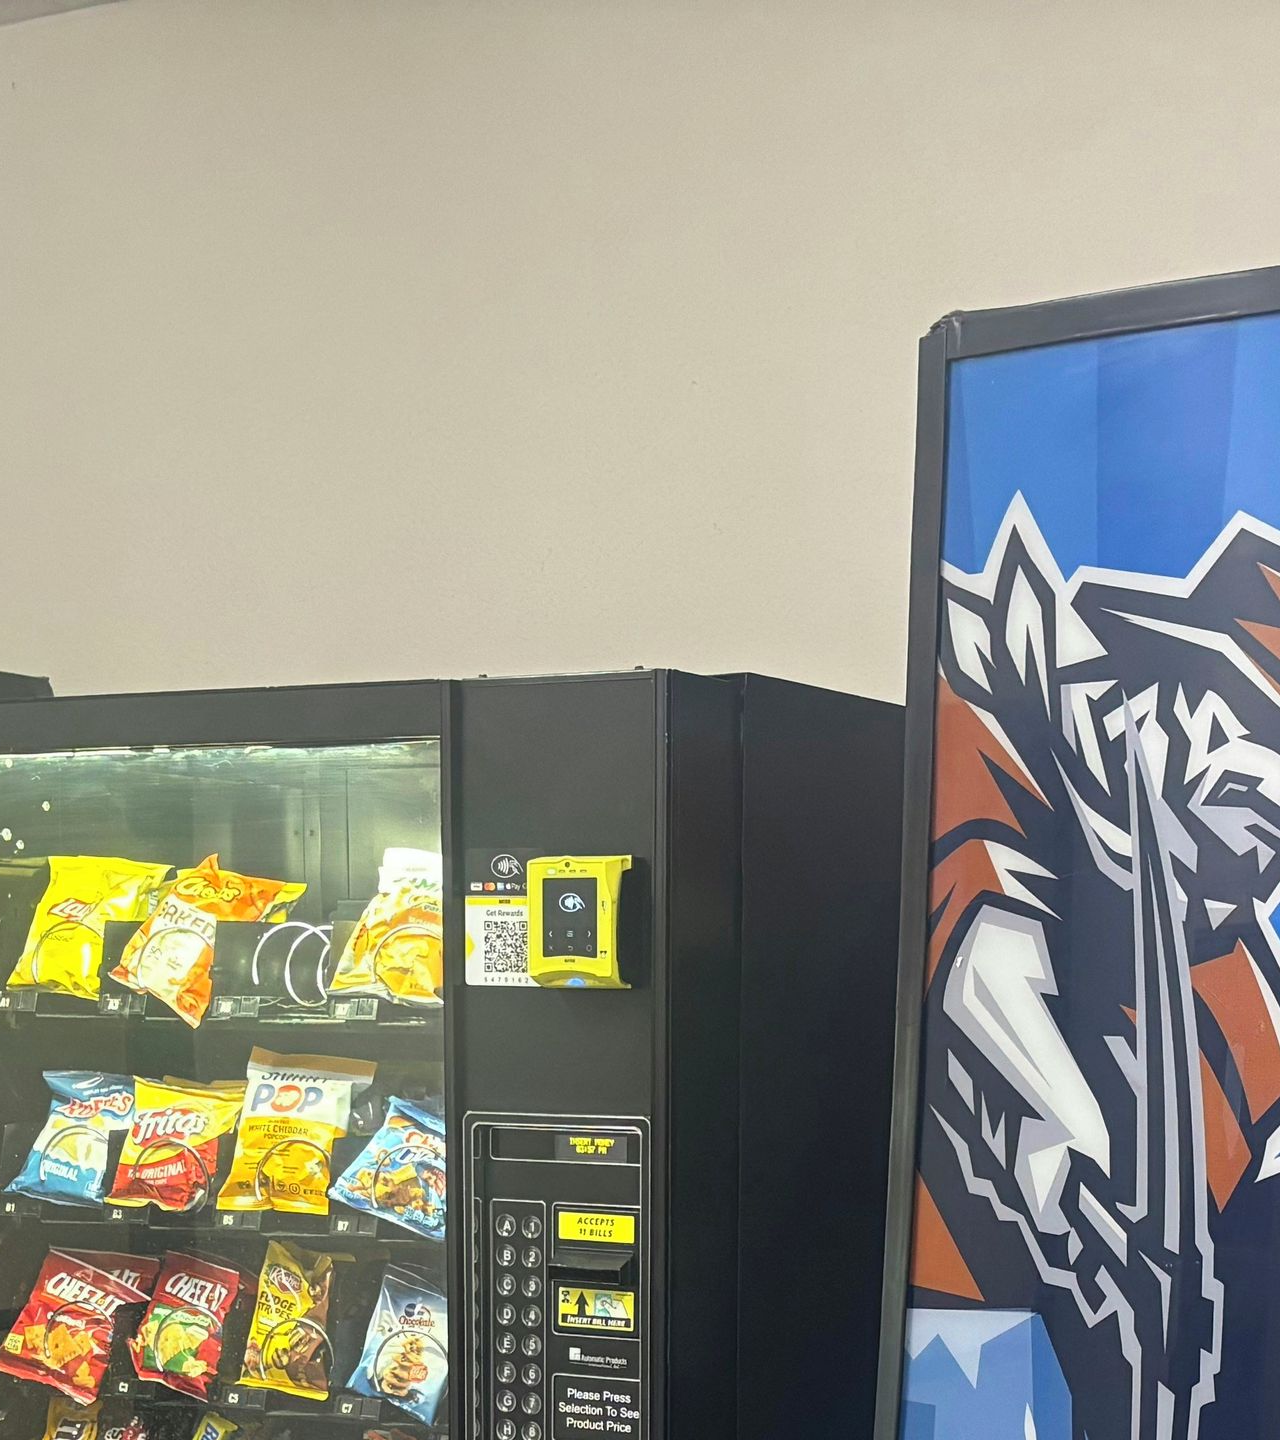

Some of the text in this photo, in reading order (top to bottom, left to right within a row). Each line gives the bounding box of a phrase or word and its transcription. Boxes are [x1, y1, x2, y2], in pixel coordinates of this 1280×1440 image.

[486, 909, 523, 917] Get Rewards
[250, 1083, 324, 1113] POP
[132, 1108, 208, 1144] Fritos
[272, 1124, 309, 1137] CHEDDAR
[569, 1136, 615, 1147] INSERT MONEY
[141, 1160, 187, 1179] ORIGINAL
[5, 1203, 15, 1213] B1
[112, 1209, 122, 1219] B3
[222, 1215, 234, 1225] B5
[577, 1216, 615, 1227] ACCEPTS
[337, 1221, 349, 1231] B7
[503, 1221, 512, 1231] A
[589, 1228, 613, 1238] BILLS
[503, 1250, 511, 1260] B
[529, 1251, 536, 1262] 2
[503, 1279, 511, 1289] C
[503, 1309, 511, 1319] D
[528, 1310, 536, 1321] 4
[567, 1314, 626, 1327] INSERT BILL HERE
[581, 1354, 628, 1365] Automatic Products
[567, 1387, 632, 1403] Please Press
[503, 1396, 512, 1406] G
[341, 1402, 353, 1414] C7
[558, 1402, 640, 1419] Selection To See
[503, 1425, 512, 1435] H
[566, 1417, 632, 1433] Product Price
